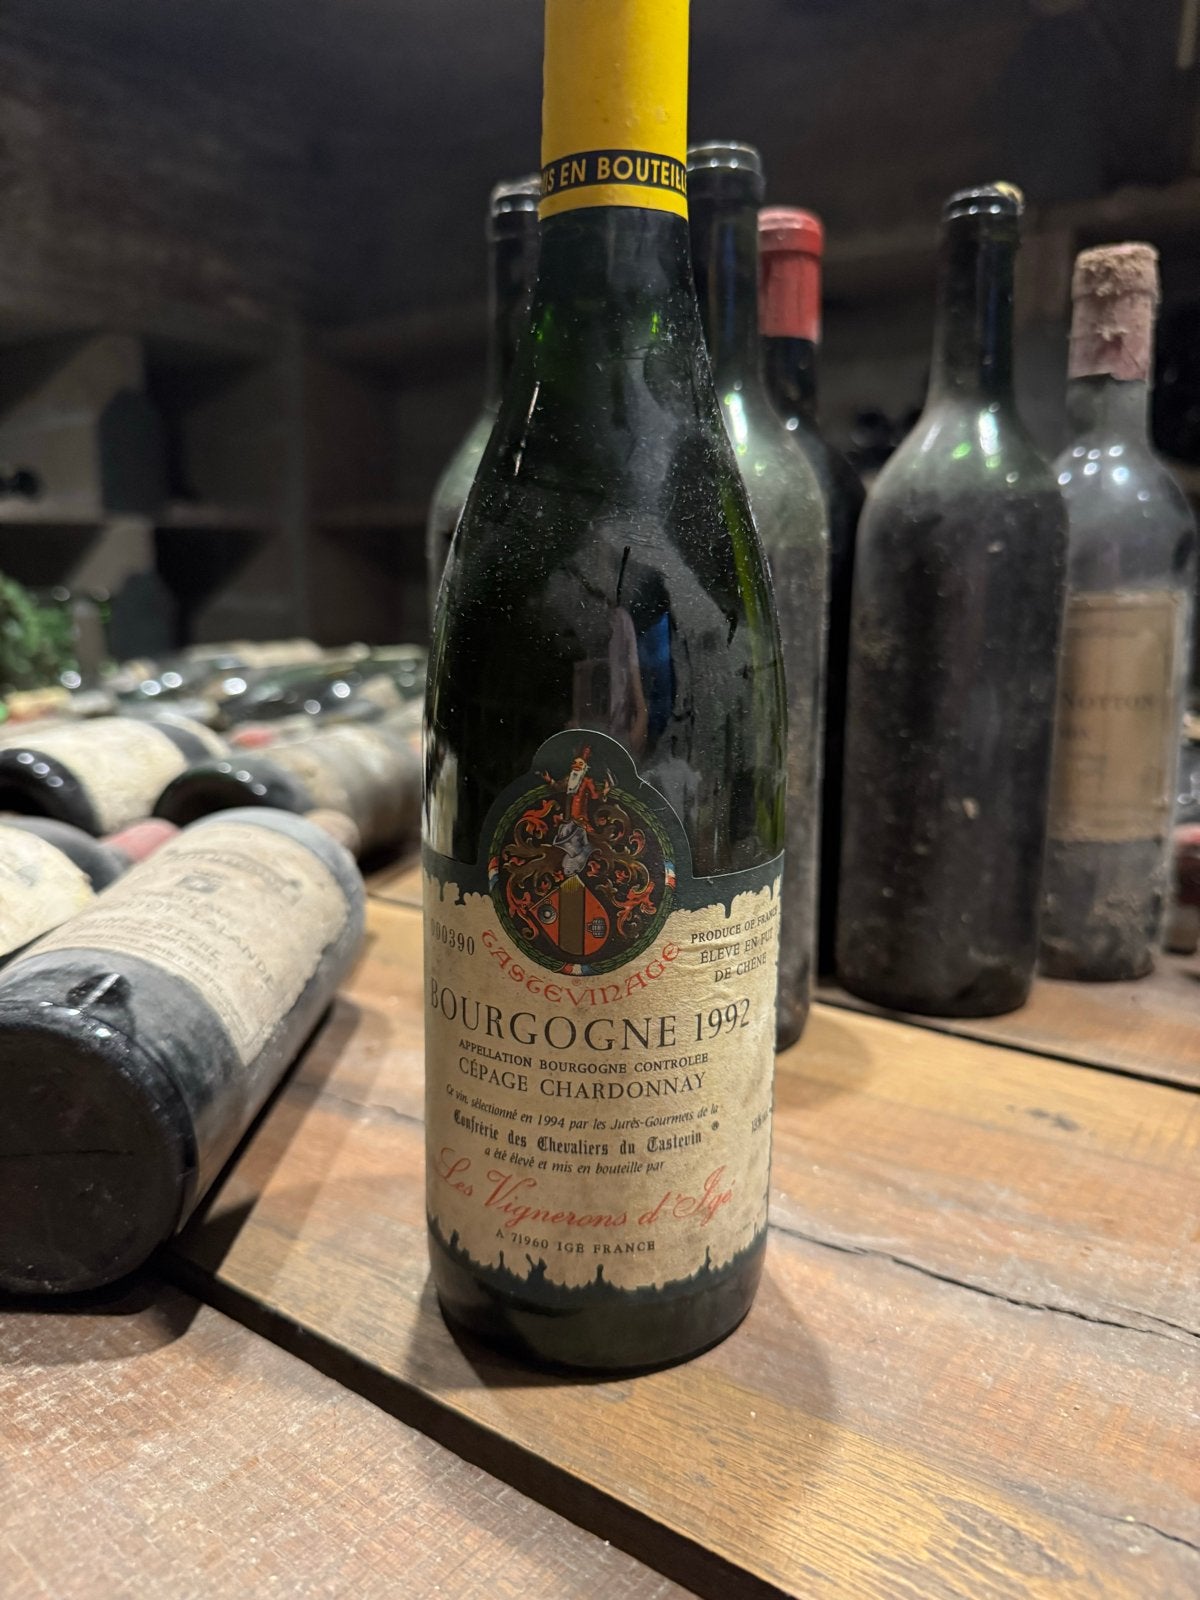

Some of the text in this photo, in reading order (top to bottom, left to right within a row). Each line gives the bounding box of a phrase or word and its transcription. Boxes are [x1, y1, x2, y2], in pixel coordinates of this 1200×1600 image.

[543, 156, 687, 195] IS EN BOUTEILL
[691, 924, 741, 944] PRODUCE
[744, 918, 755, 931] OF
[745, 936, 758, 952] EN
[481, 929, 682, 1007] TASTEVINAGE
[714, 967, 732, 983] DE
[431, 977, 750, 1051] BOURGOGNE 1992
[458, 1038, 532, 1068] APPELLATION
[540, 1059, 627, 1075] BOURGOGNE
[459, 1056, 706, 1100] CÉPAGE CHARDONNAY
[471, 1098, 518, 1120] sélectionné
[520, 1113, 533, 1124] en
[538, 1114, 565, 1128] 1994
[569, 1120, 589, 1131] par
[592, 1118, 607, 1130] les
[697, 1106, 708, 1119] de
[710, 1103, 719, 1115] la
[508, 1129, 527, 1148] des
[537, 1135, 609, 1156] Chevaliers
[620, 1139, 635, 1155] du
[647, 1130, 702, 1153] Tastevin
[484, 1147, 491, 1156] a
[509, 1152, 535, 1169] élevé
[538, 1160, 547, 1170] et
[552, 1162, 572, 1174] mis
[577, 1164, 591, 1174] en
[595, 1162, 643, 1175] bouteille
[646, 1161, 664, 1173] par
[434, 1147, 473, 1196] Les
[484, 1169, 628, 1228] Vignerons
[496, 1228, 504, 1239] A
[511, 1232, 549, 1249] 71960
[593, 1240, 656, 1254] FRANCE
